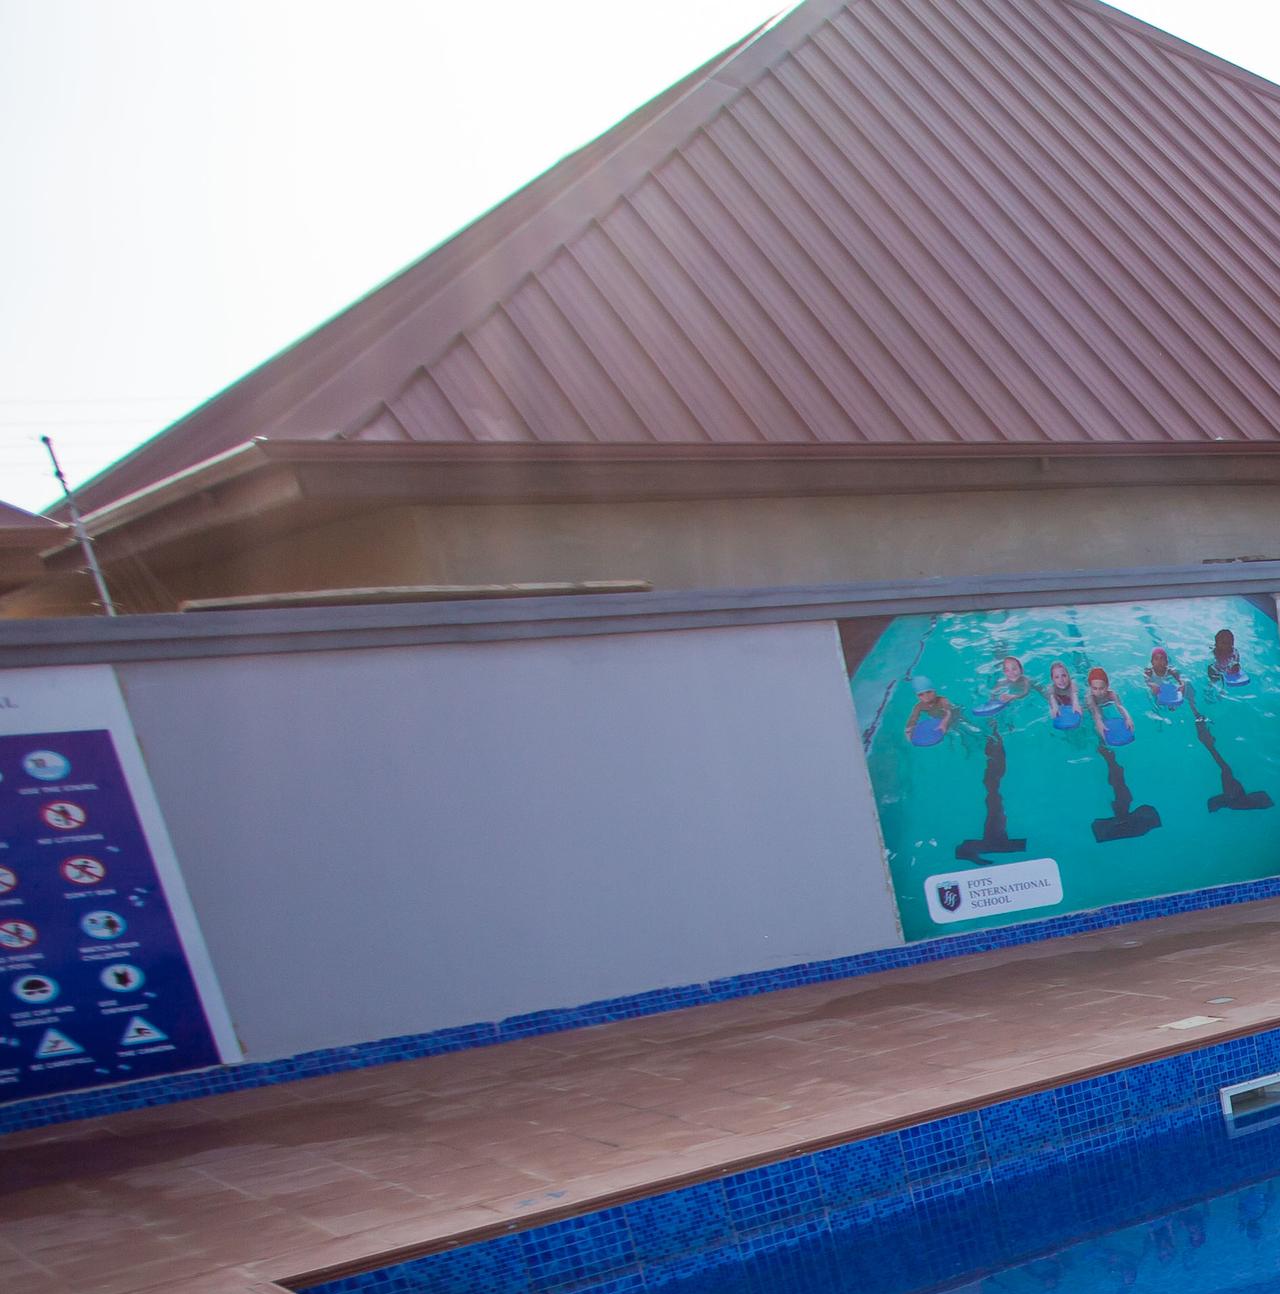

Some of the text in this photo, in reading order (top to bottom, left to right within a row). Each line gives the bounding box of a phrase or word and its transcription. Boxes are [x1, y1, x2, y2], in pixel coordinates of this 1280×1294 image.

[967, 877, 993, 889] FOTS
[969, 879, 1052, 899] INTERNATIONAL
[971, 895, 1013, 910] SCHOOL
